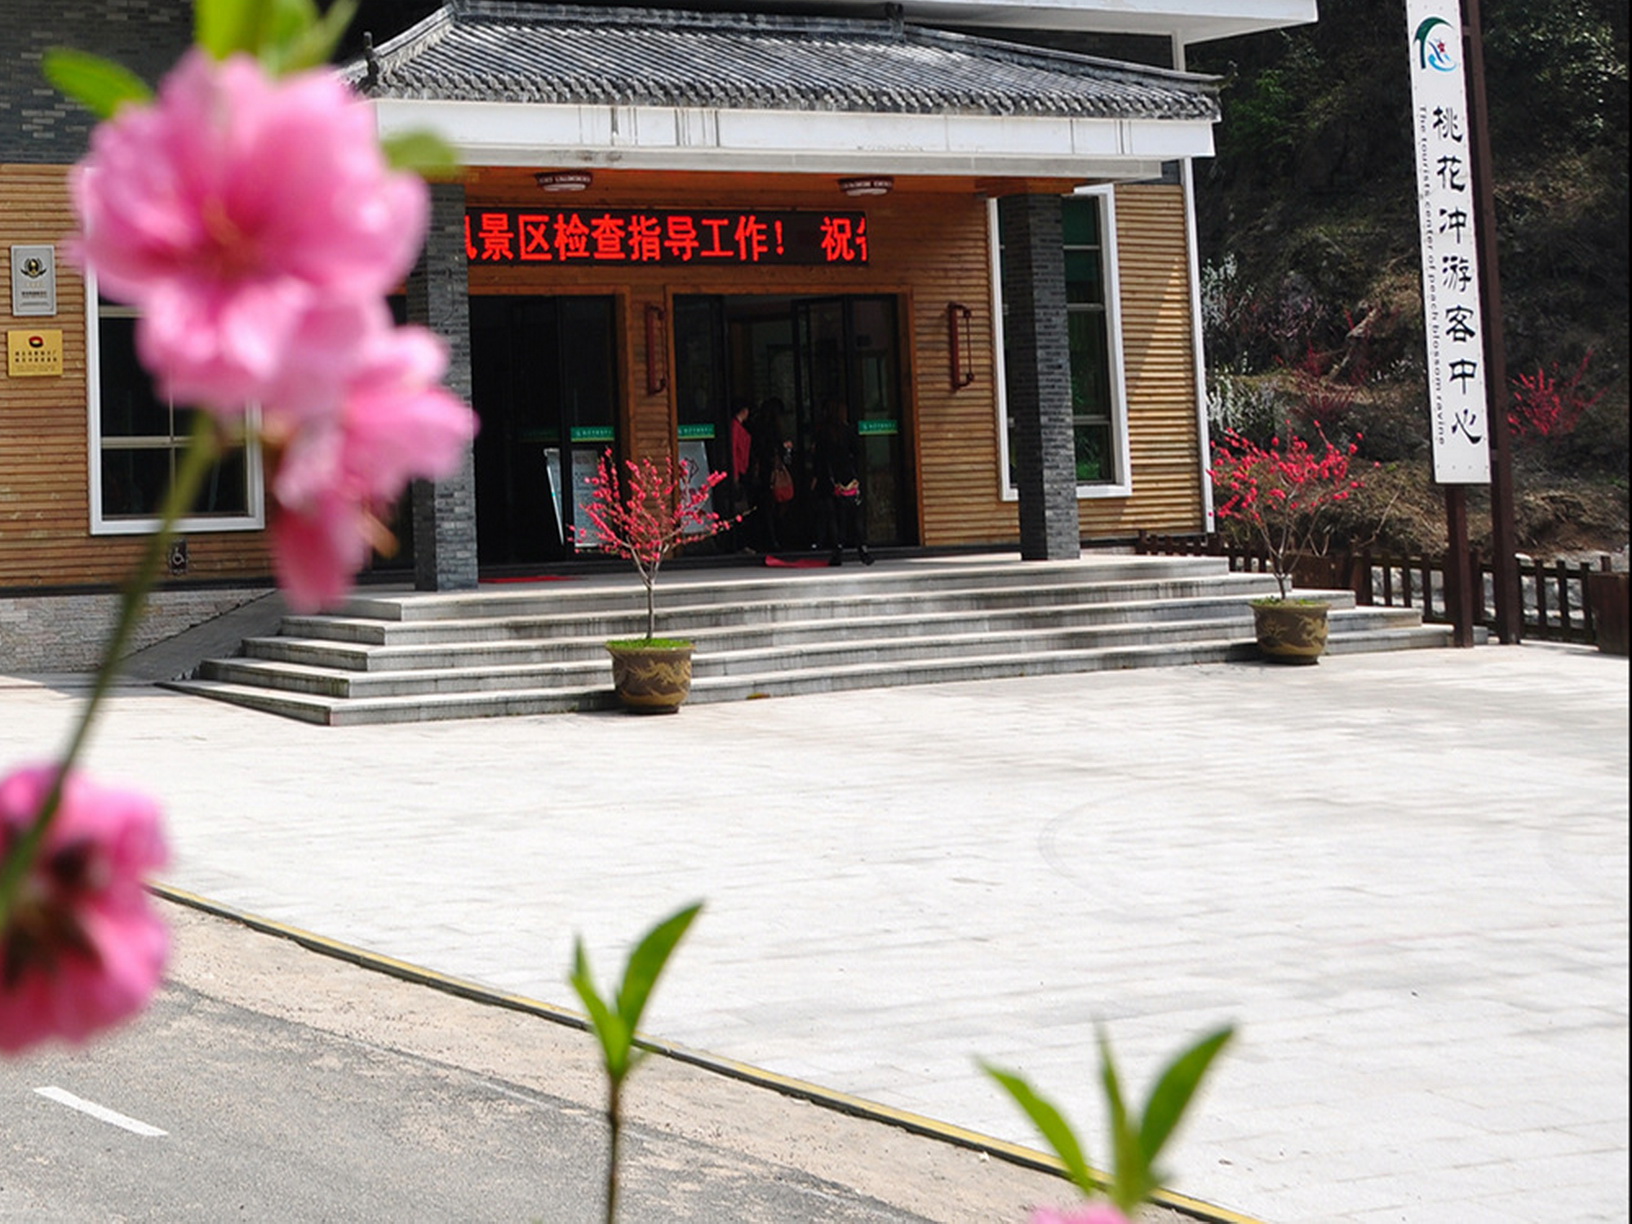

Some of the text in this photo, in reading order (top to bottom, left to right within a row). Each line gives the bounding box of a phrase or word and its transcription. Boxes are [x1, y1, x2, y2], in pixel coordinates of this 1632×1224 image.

[1424, 201, 1434, 251] center
[1428, 272, 1439, 320] peach
[1432, 105, 1482, 445] 桃花冲游客中心
[1432, 322, 1443, 392] blossom
